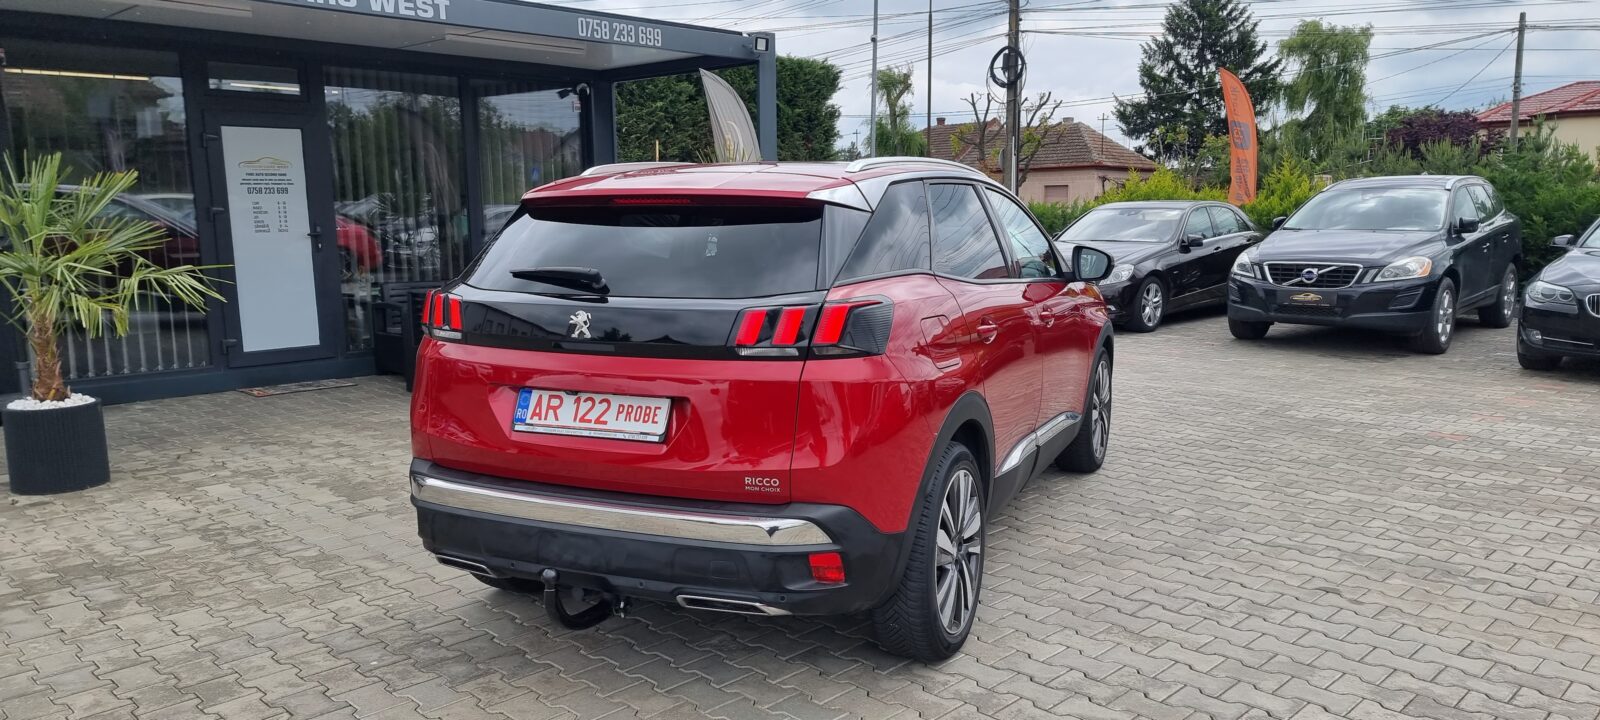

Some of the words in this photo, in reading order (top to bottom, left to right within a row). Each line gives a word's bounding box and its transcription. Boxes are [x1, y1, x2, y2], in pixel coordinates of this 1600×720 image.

[369, 0, 450, 20] WEST
[577, 17, 610, 40] 0758
[612, 22, 636, 43] 233
[638, 26, 662, 47] 699
[247, 186, 263, 195] 0758
[263, 186, 276, 195] 233
[276, 187, 289, 195] 699
[515, 408, 528, 420] RO
[529, 394, 564, 422] AR
[572, 396, 612, 426] 122
[615, 403, 662, 425] PROBE
[744, 476, 780, 487] RICCO
